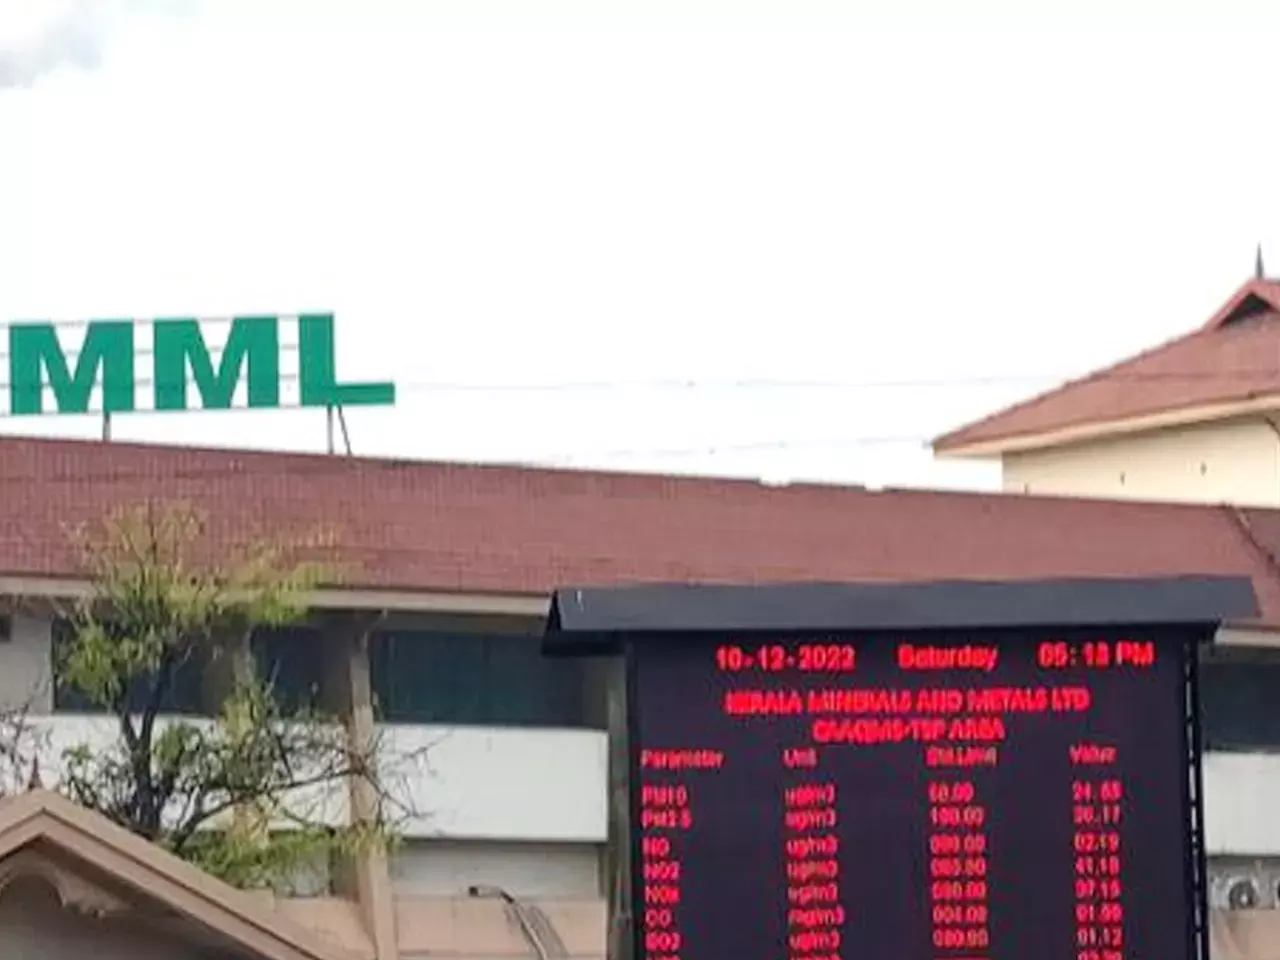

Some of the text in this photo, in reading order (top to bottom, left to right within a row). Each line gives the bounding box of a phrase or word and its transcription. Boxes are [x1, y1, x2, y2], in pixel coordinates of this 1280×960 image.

[716, 645, 856, 671] 10-12-2022
[898, 644, 998, 671] Saturday
[1116, 640, 1154, 666] PM
[1051, 686, 1090, 711] LTD
